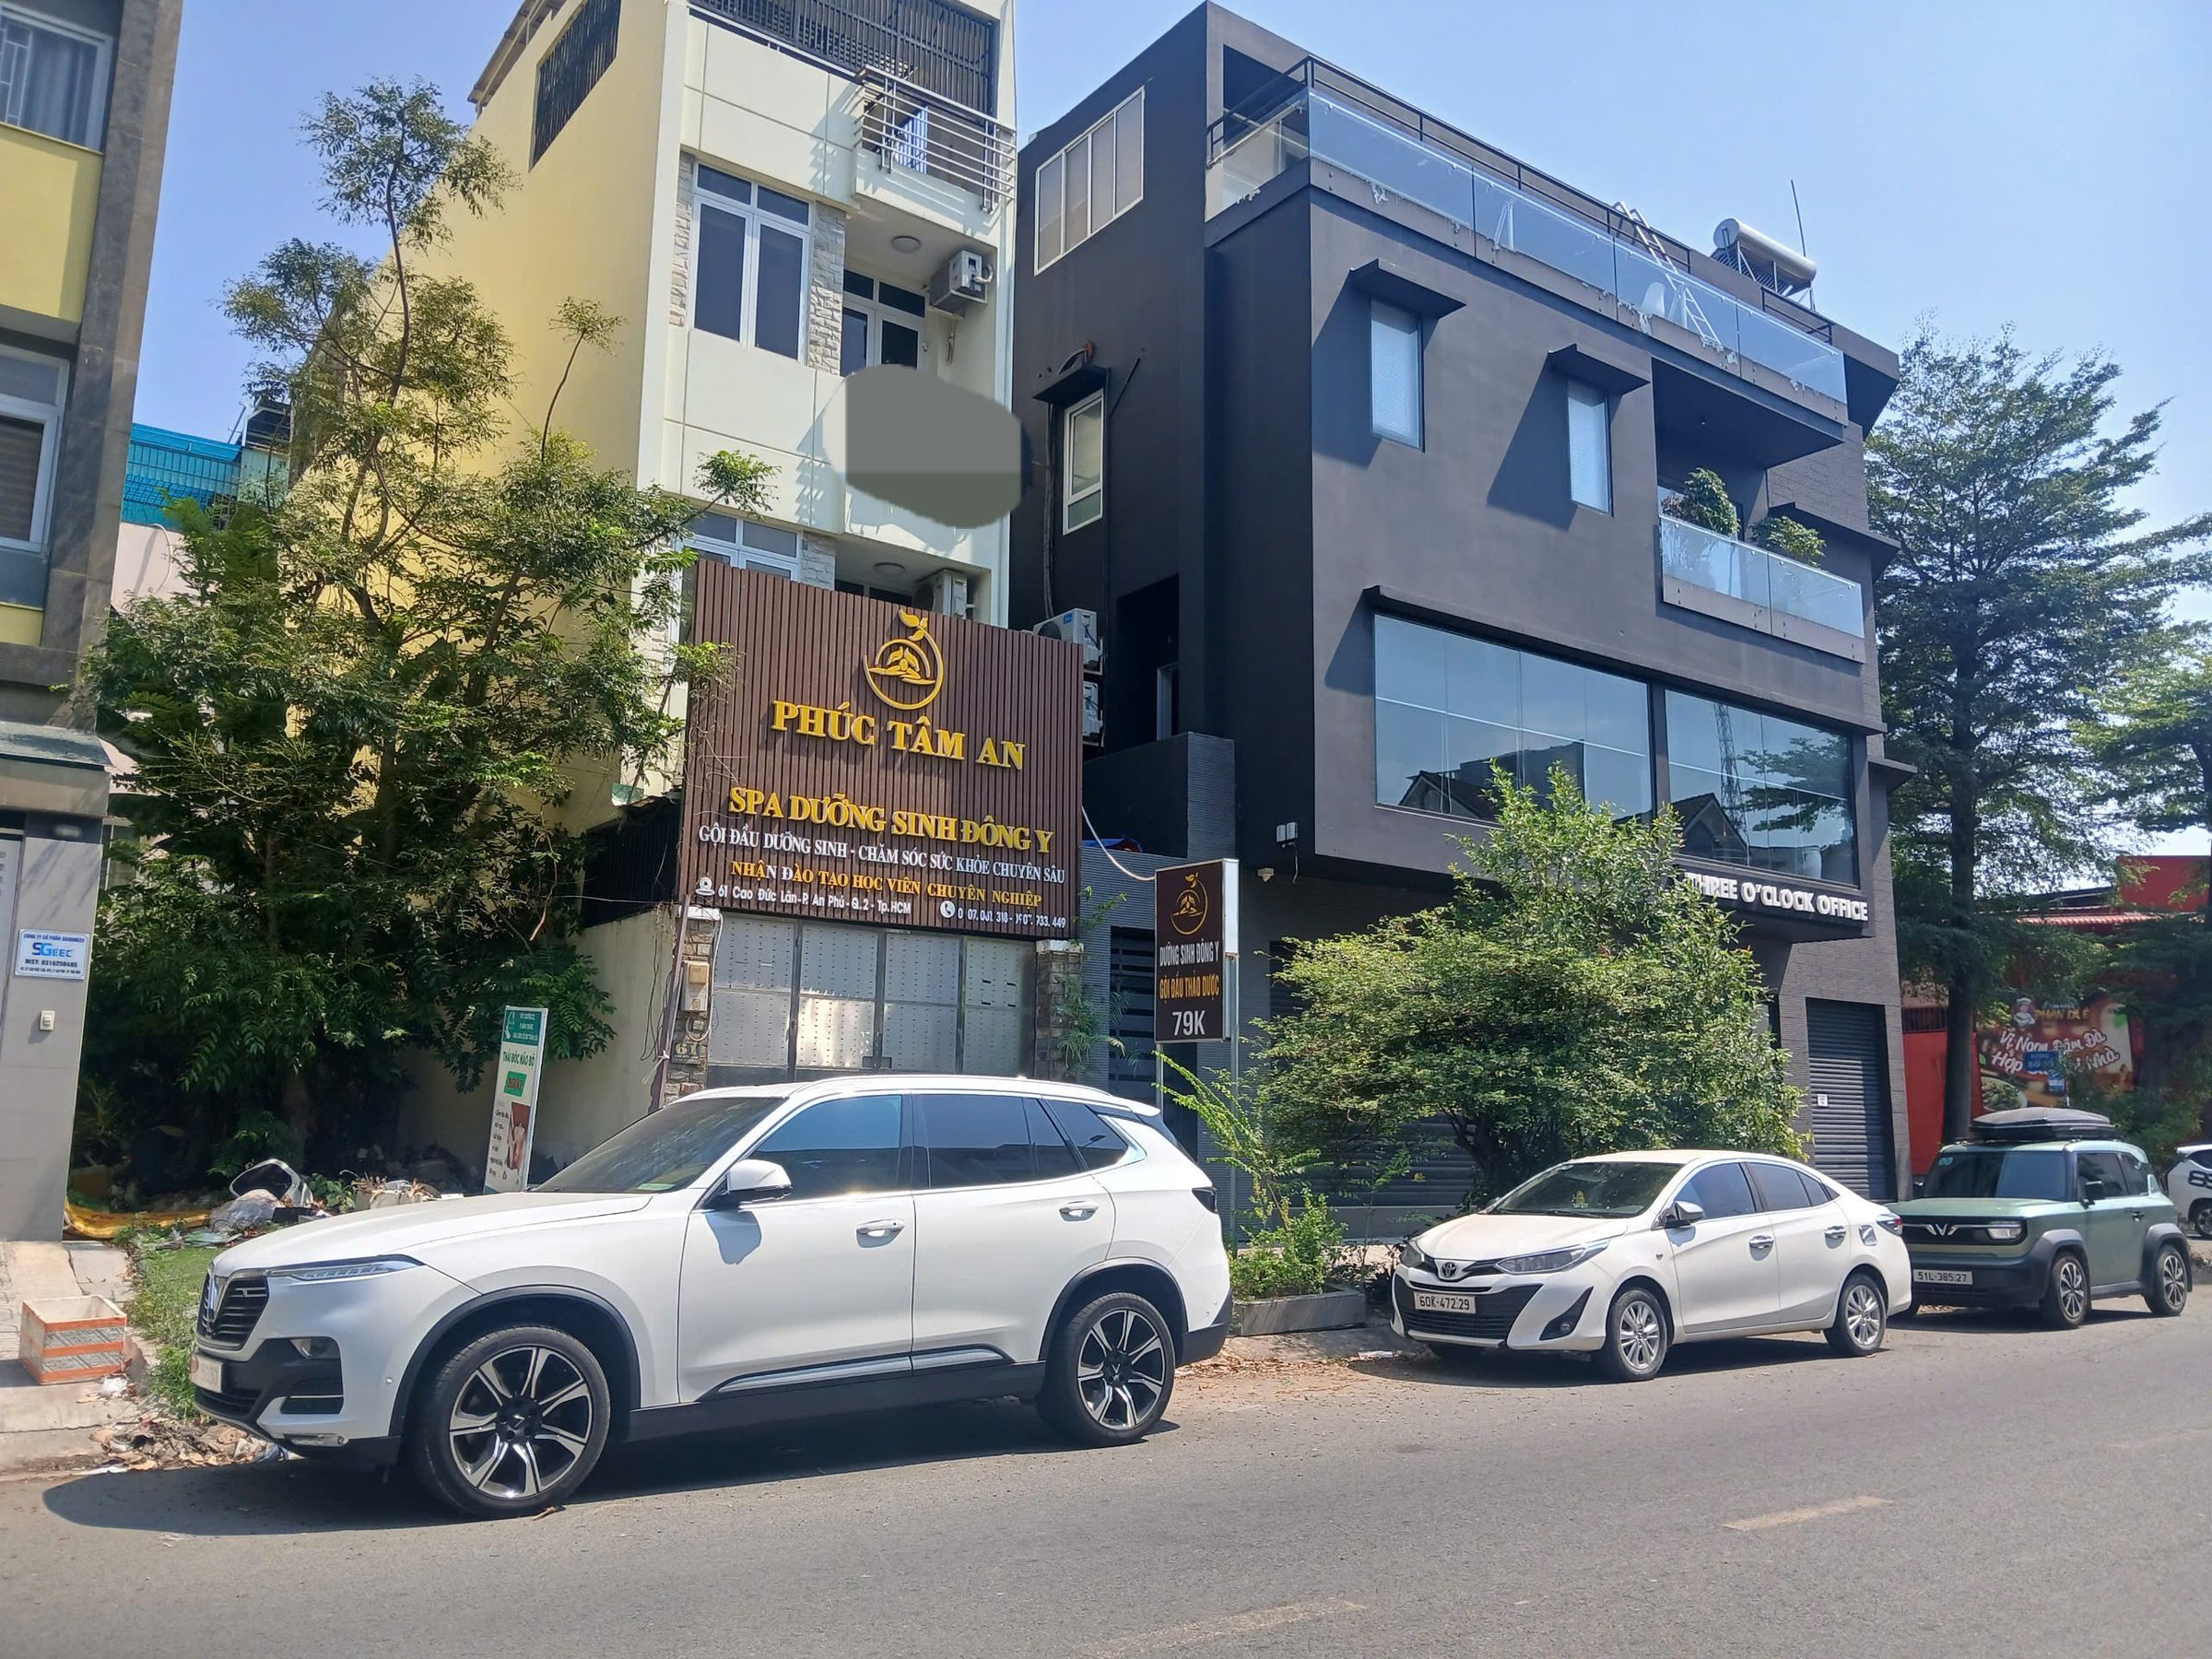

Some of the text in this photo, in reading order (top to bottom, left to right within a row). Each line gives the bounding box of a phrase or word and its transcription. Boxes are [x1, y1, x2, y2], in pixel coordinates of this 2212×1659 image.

[771, 700, 1025, 771] PHÚC TÂM AN
[729, 787, 1054, 853] SPA DƯỠNG SINH ĐÔNG Y
[699, 822, 726, 847] GỘI
[727, 823, 759, 848] ĐẦU
[763, 830, 811, 854] DƯỠNG
[815, 840, 848, 858] SINH
[858, 842, 899, 865] CHĂM
[901, 847, 927, 867] SÓC
[930, 851, 953, 870] SỨC
[956, 855, 990, 875] KHỎE
[993, 862, 1041, 881] CHUYÊN
[1044, 865, 1065, 884] SÂU
[718, 885, 728, 898] 61
[732, 886, 753, 900] Cao
[758, 888, 777, 902] Đức
[812, 895, 825, 907] An
[828, 895, 844, 908] Phú
[731, 860, 1042, 910] NHẬN ĐÀO TẠO HỌC VIÊN CHUYÊN NGHIỆP
[1684, 872, 1868, 921] THREE O'CLOCK OFFICE
[1214, 941, 1220, 962] Y
[1172, 1010, 1206, 1036] 79K
[1419, 1296, 1469, 1310] 60K-472.29
